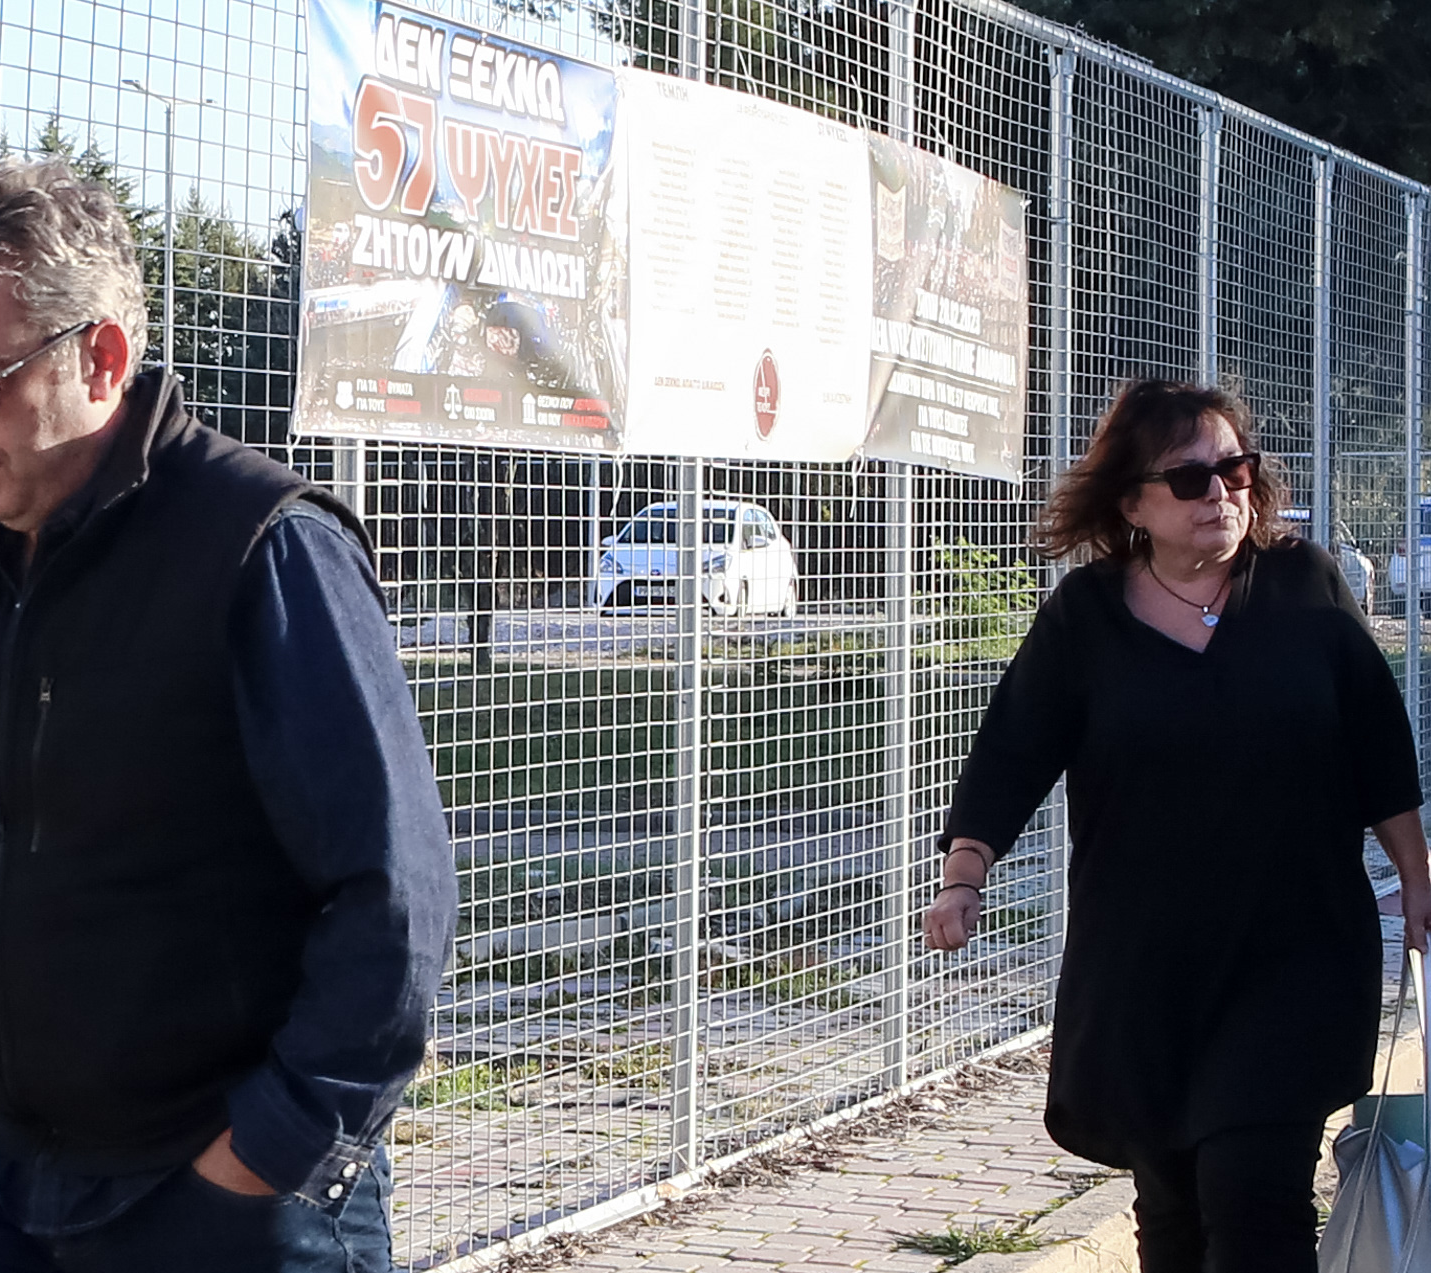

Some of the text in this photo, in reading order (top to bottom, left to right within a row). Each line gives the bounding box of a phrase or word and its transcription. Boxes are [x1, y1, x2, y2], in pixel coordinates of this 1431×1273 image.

[376, 14, 565, 123] ΔΕΝ ΞΕΧΝΩ
[353, 75, 438, 216] 57
[444, 119, 583, 241] ΨΥΧΕΣ
[352, 216, 586, 300] ΖΗΤΟΥΝ ΔΙΚΑΙΩΣΗ
